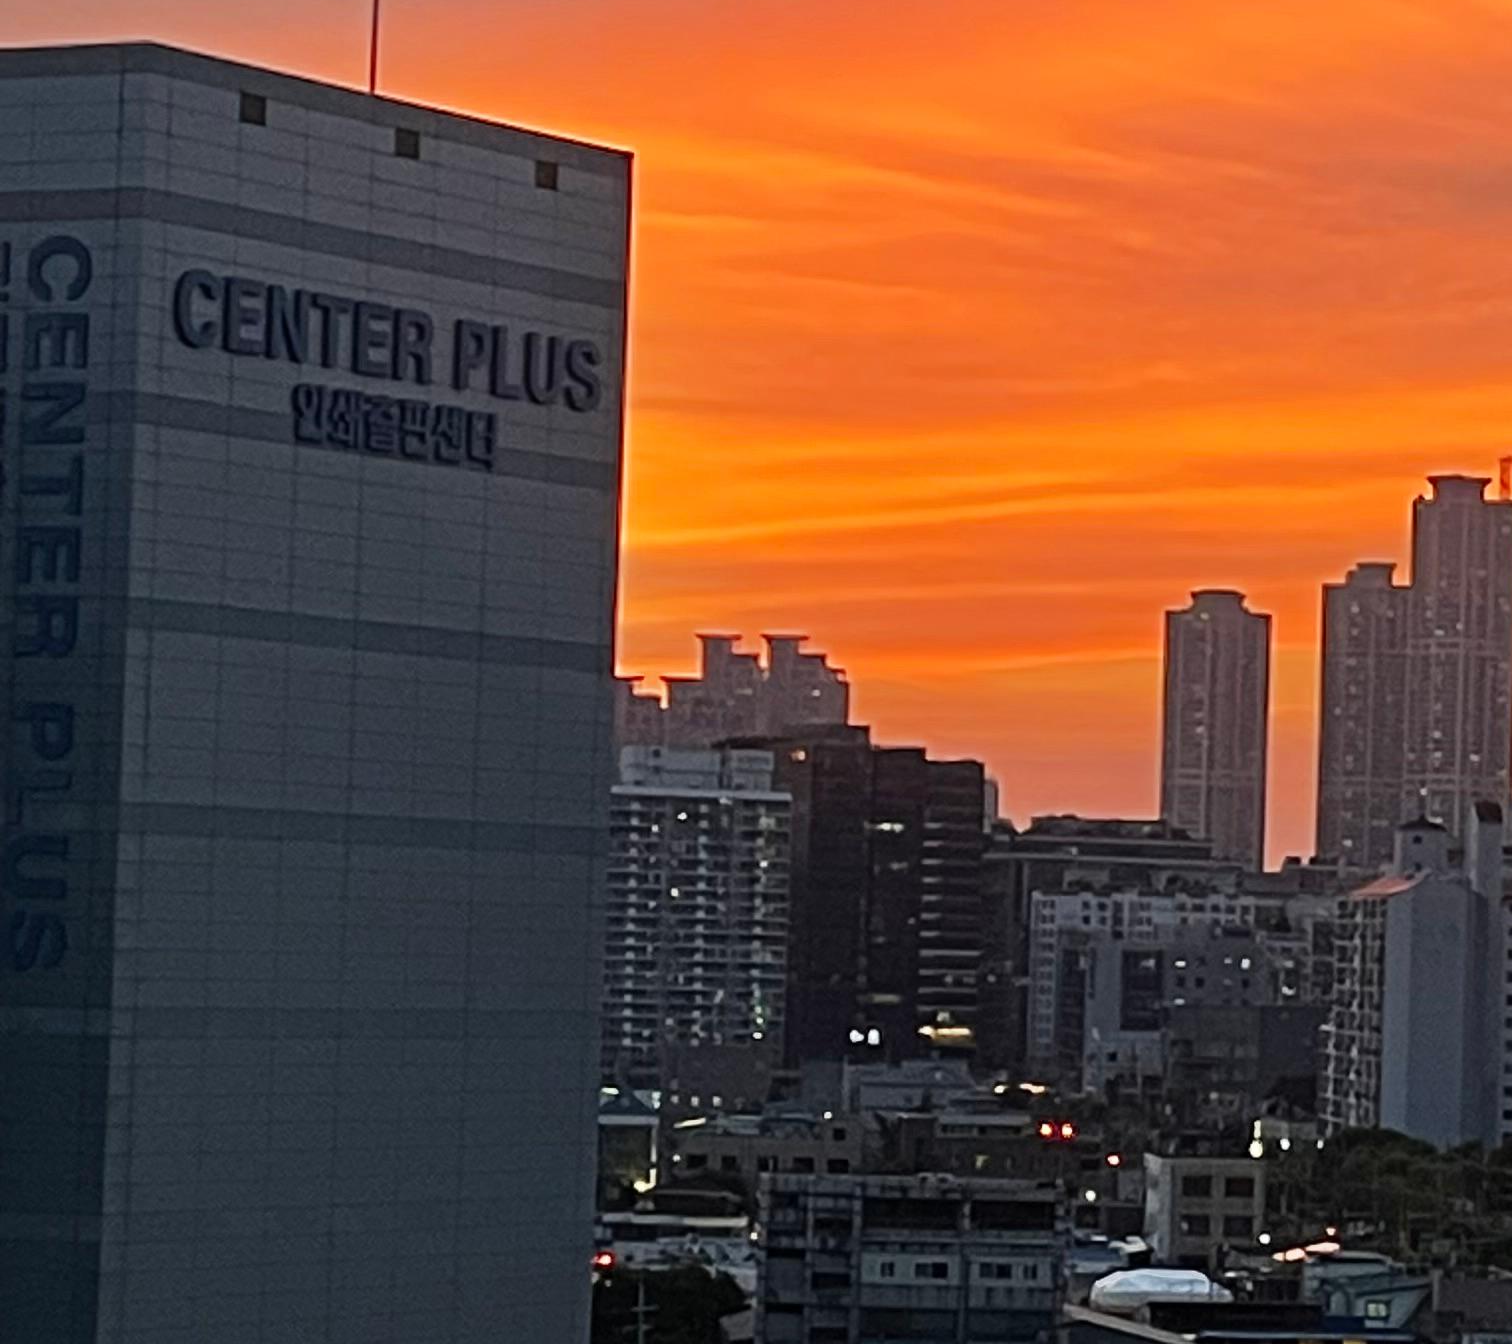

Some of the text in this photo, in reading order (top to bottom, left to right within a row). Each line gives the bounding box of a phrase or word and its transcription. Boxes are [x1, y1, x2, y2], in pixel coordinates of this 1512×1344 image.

[171, 267, 601, 414] CENTER PLUS
[6, 233, 93, 973] CENTER PLUS
